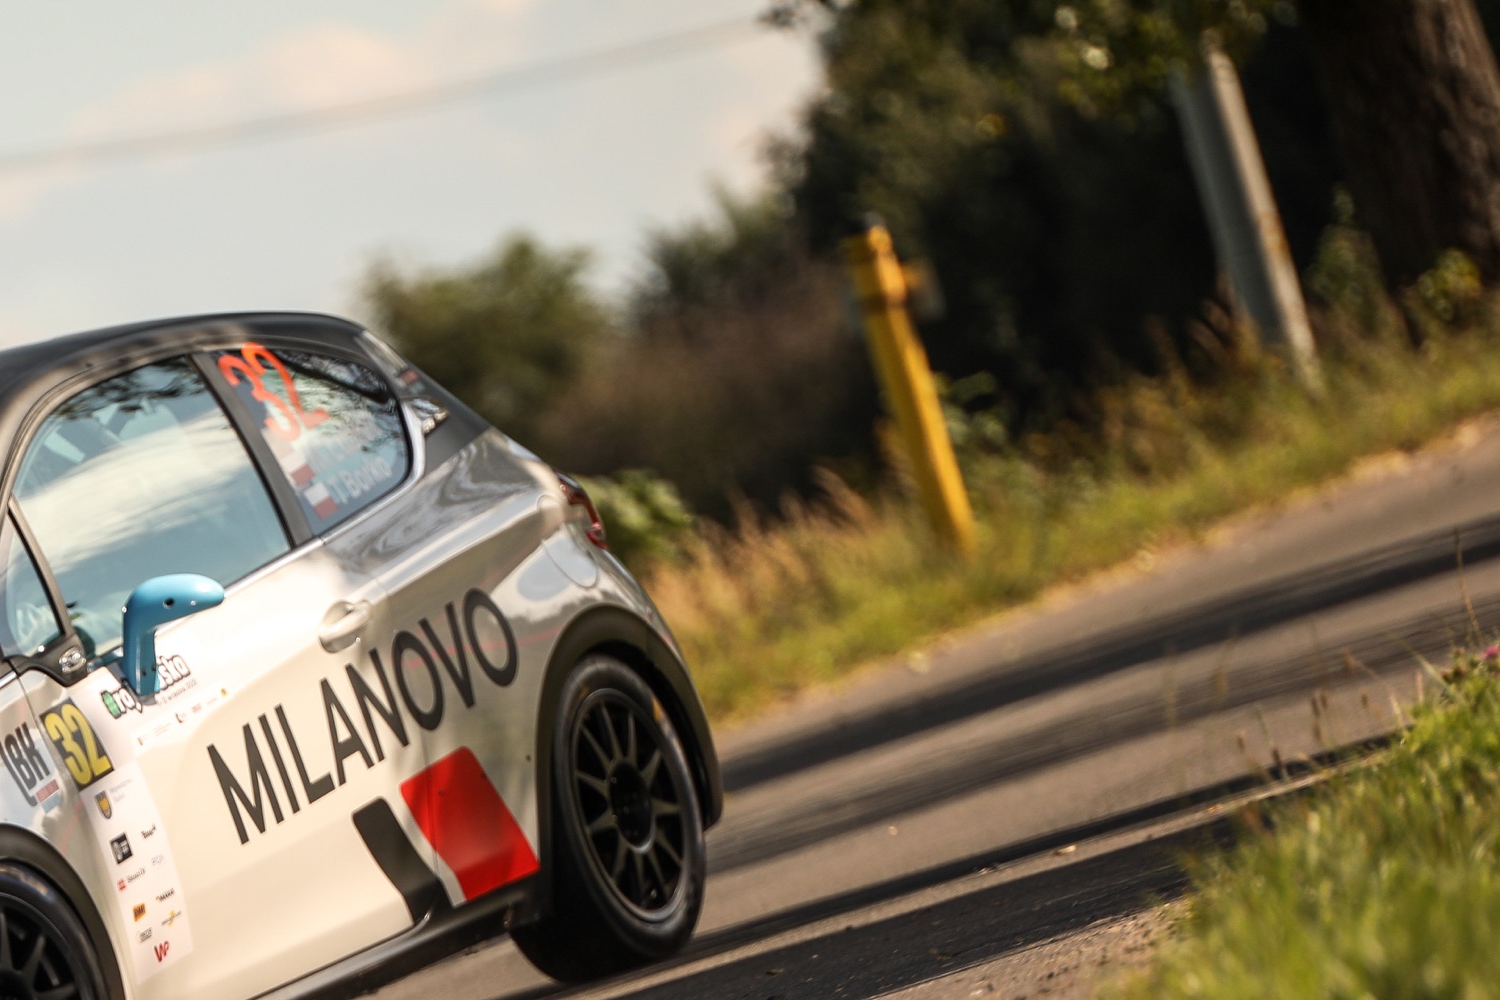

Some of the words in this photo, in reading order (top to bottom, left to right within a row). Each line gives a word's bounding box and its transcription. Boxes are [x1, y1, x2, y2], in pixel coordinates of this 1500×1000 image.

[217, 342, 330, 441] 32
[44, 703, 112, 785] 32
[206, 587, 519, 845] MILANOVO
